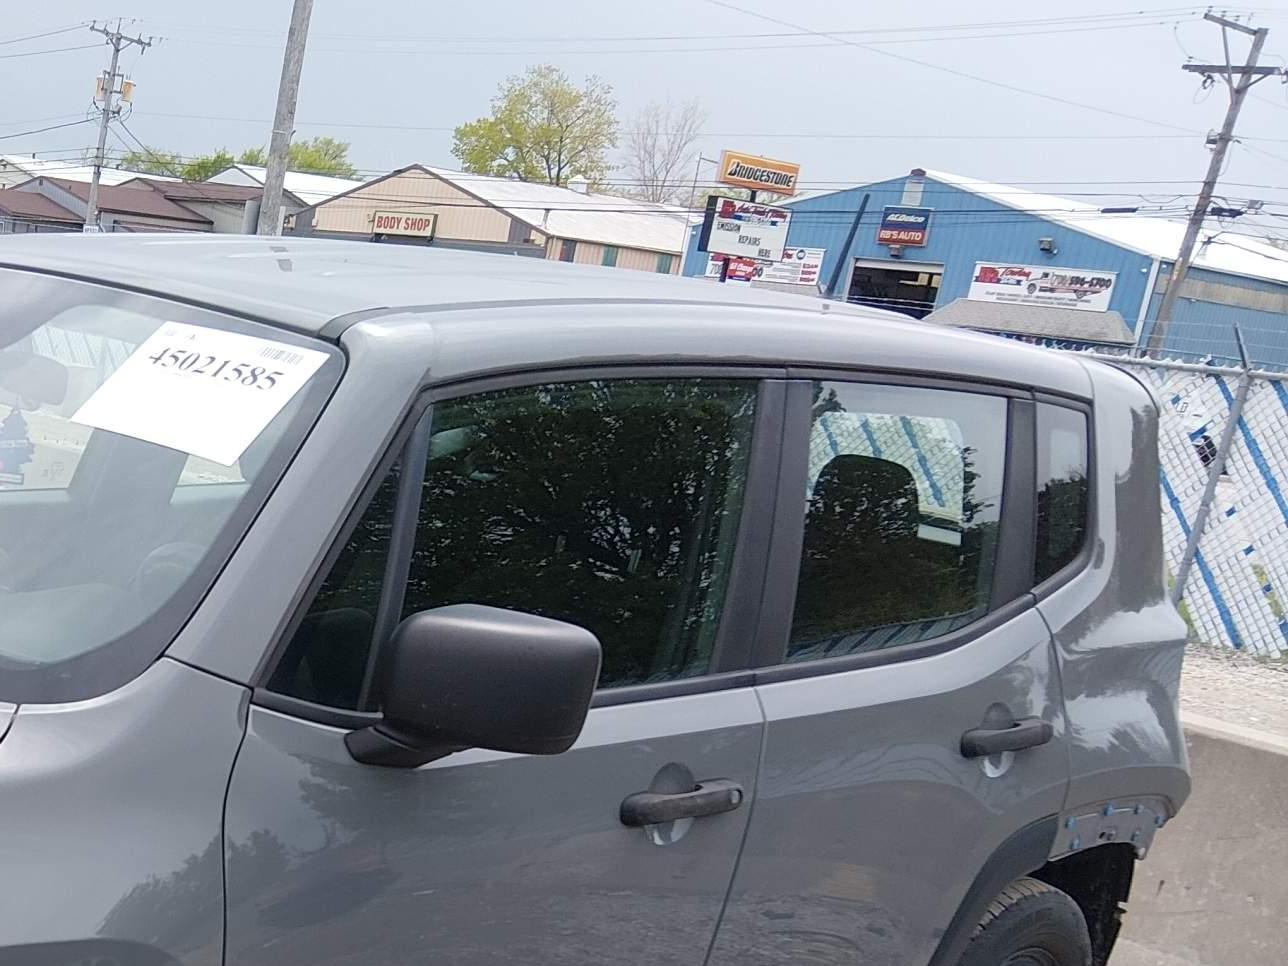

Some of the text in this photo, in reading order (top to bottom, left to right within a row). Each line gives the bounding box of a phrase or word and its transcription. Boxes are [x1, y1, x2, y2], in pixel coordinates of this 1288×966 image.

[728, 161, 794, 188] BRIDGESTONE
[376, 215, 431, 232] BODY SHOP
[717, 221, 741, 232] EMISSION
[738, 234, 761, 246] REPAIRS
[898, 231, 923, 241] AUTO
[758, 248, 772, 258] HERE
[148, 347, 285, 390] 45021585
